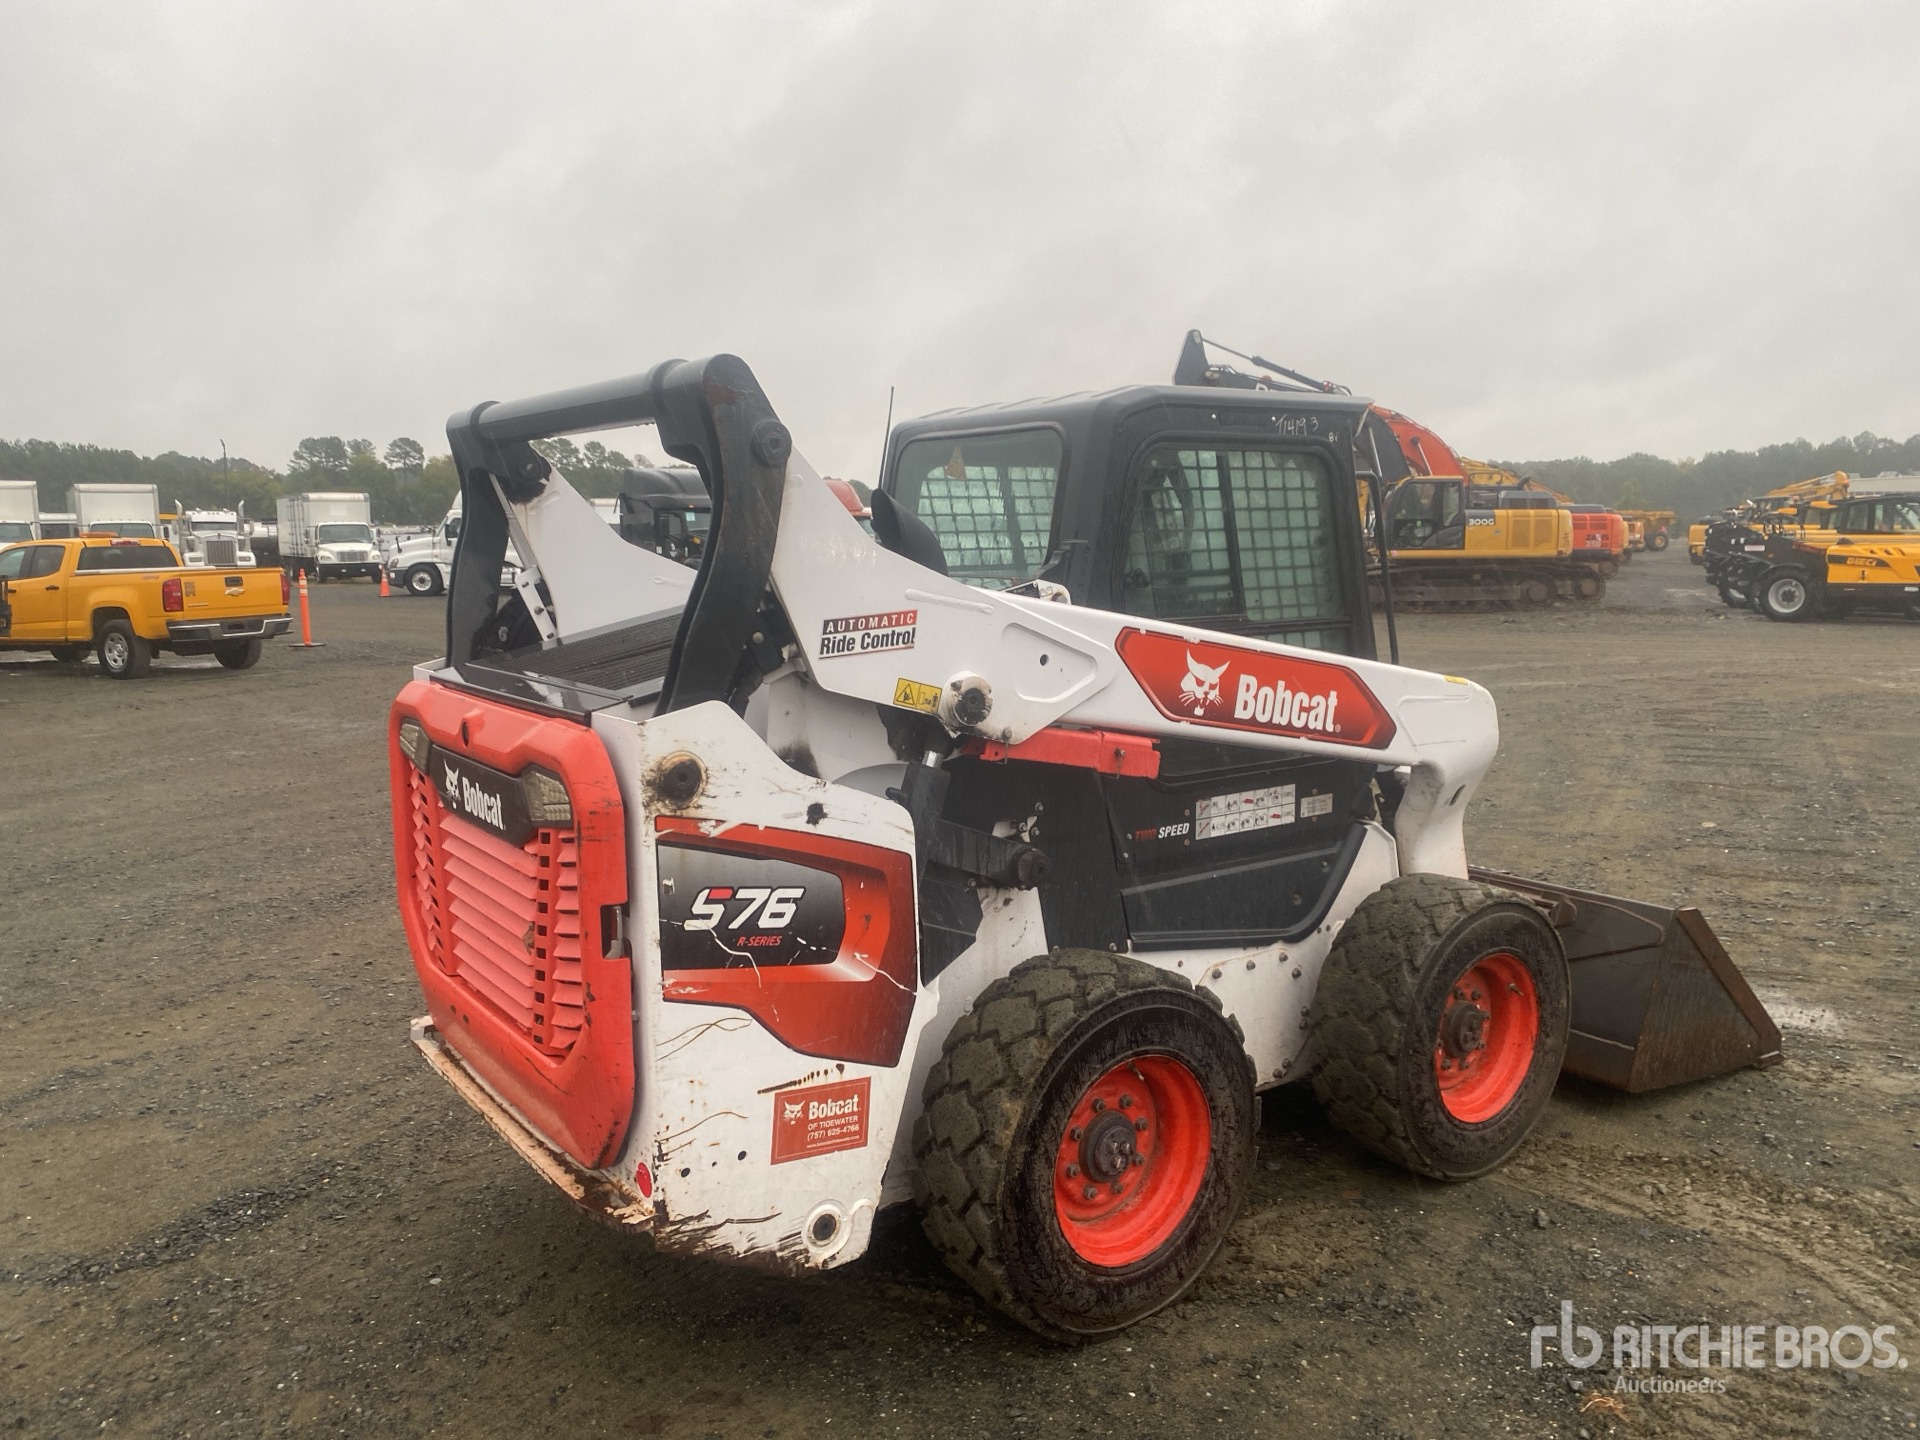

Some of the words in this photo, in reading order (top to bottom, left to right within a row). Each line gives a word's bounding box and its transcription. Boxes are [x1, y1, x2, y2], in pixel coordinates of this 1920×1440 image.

[1468, 518, 1495, 526] 300G
[1846, 557, 1878, 567] DIECI
[826, 612, 914, 633] AUTOMATIC
[820, 634, 856, 655] Ride
[860, 627, 916, 651] Control
[1234, 673, 1338, 733] Bobcat
[462, 776, 504, 831] Bobcat
[1134, 827, 1157, 842] TWO
[1158, 822, 1190, 839] SPEED
[683, 885, 805, 931] S76
[737, 936, 783, 947] R-SERIES
[808, 1094, 859, 1120] Bobcat
[807, 1122, 818, 1131] OF
[819, 1115, 859, 1129] TIDEWATER
[807, 1130, 826, 1142] (757)
